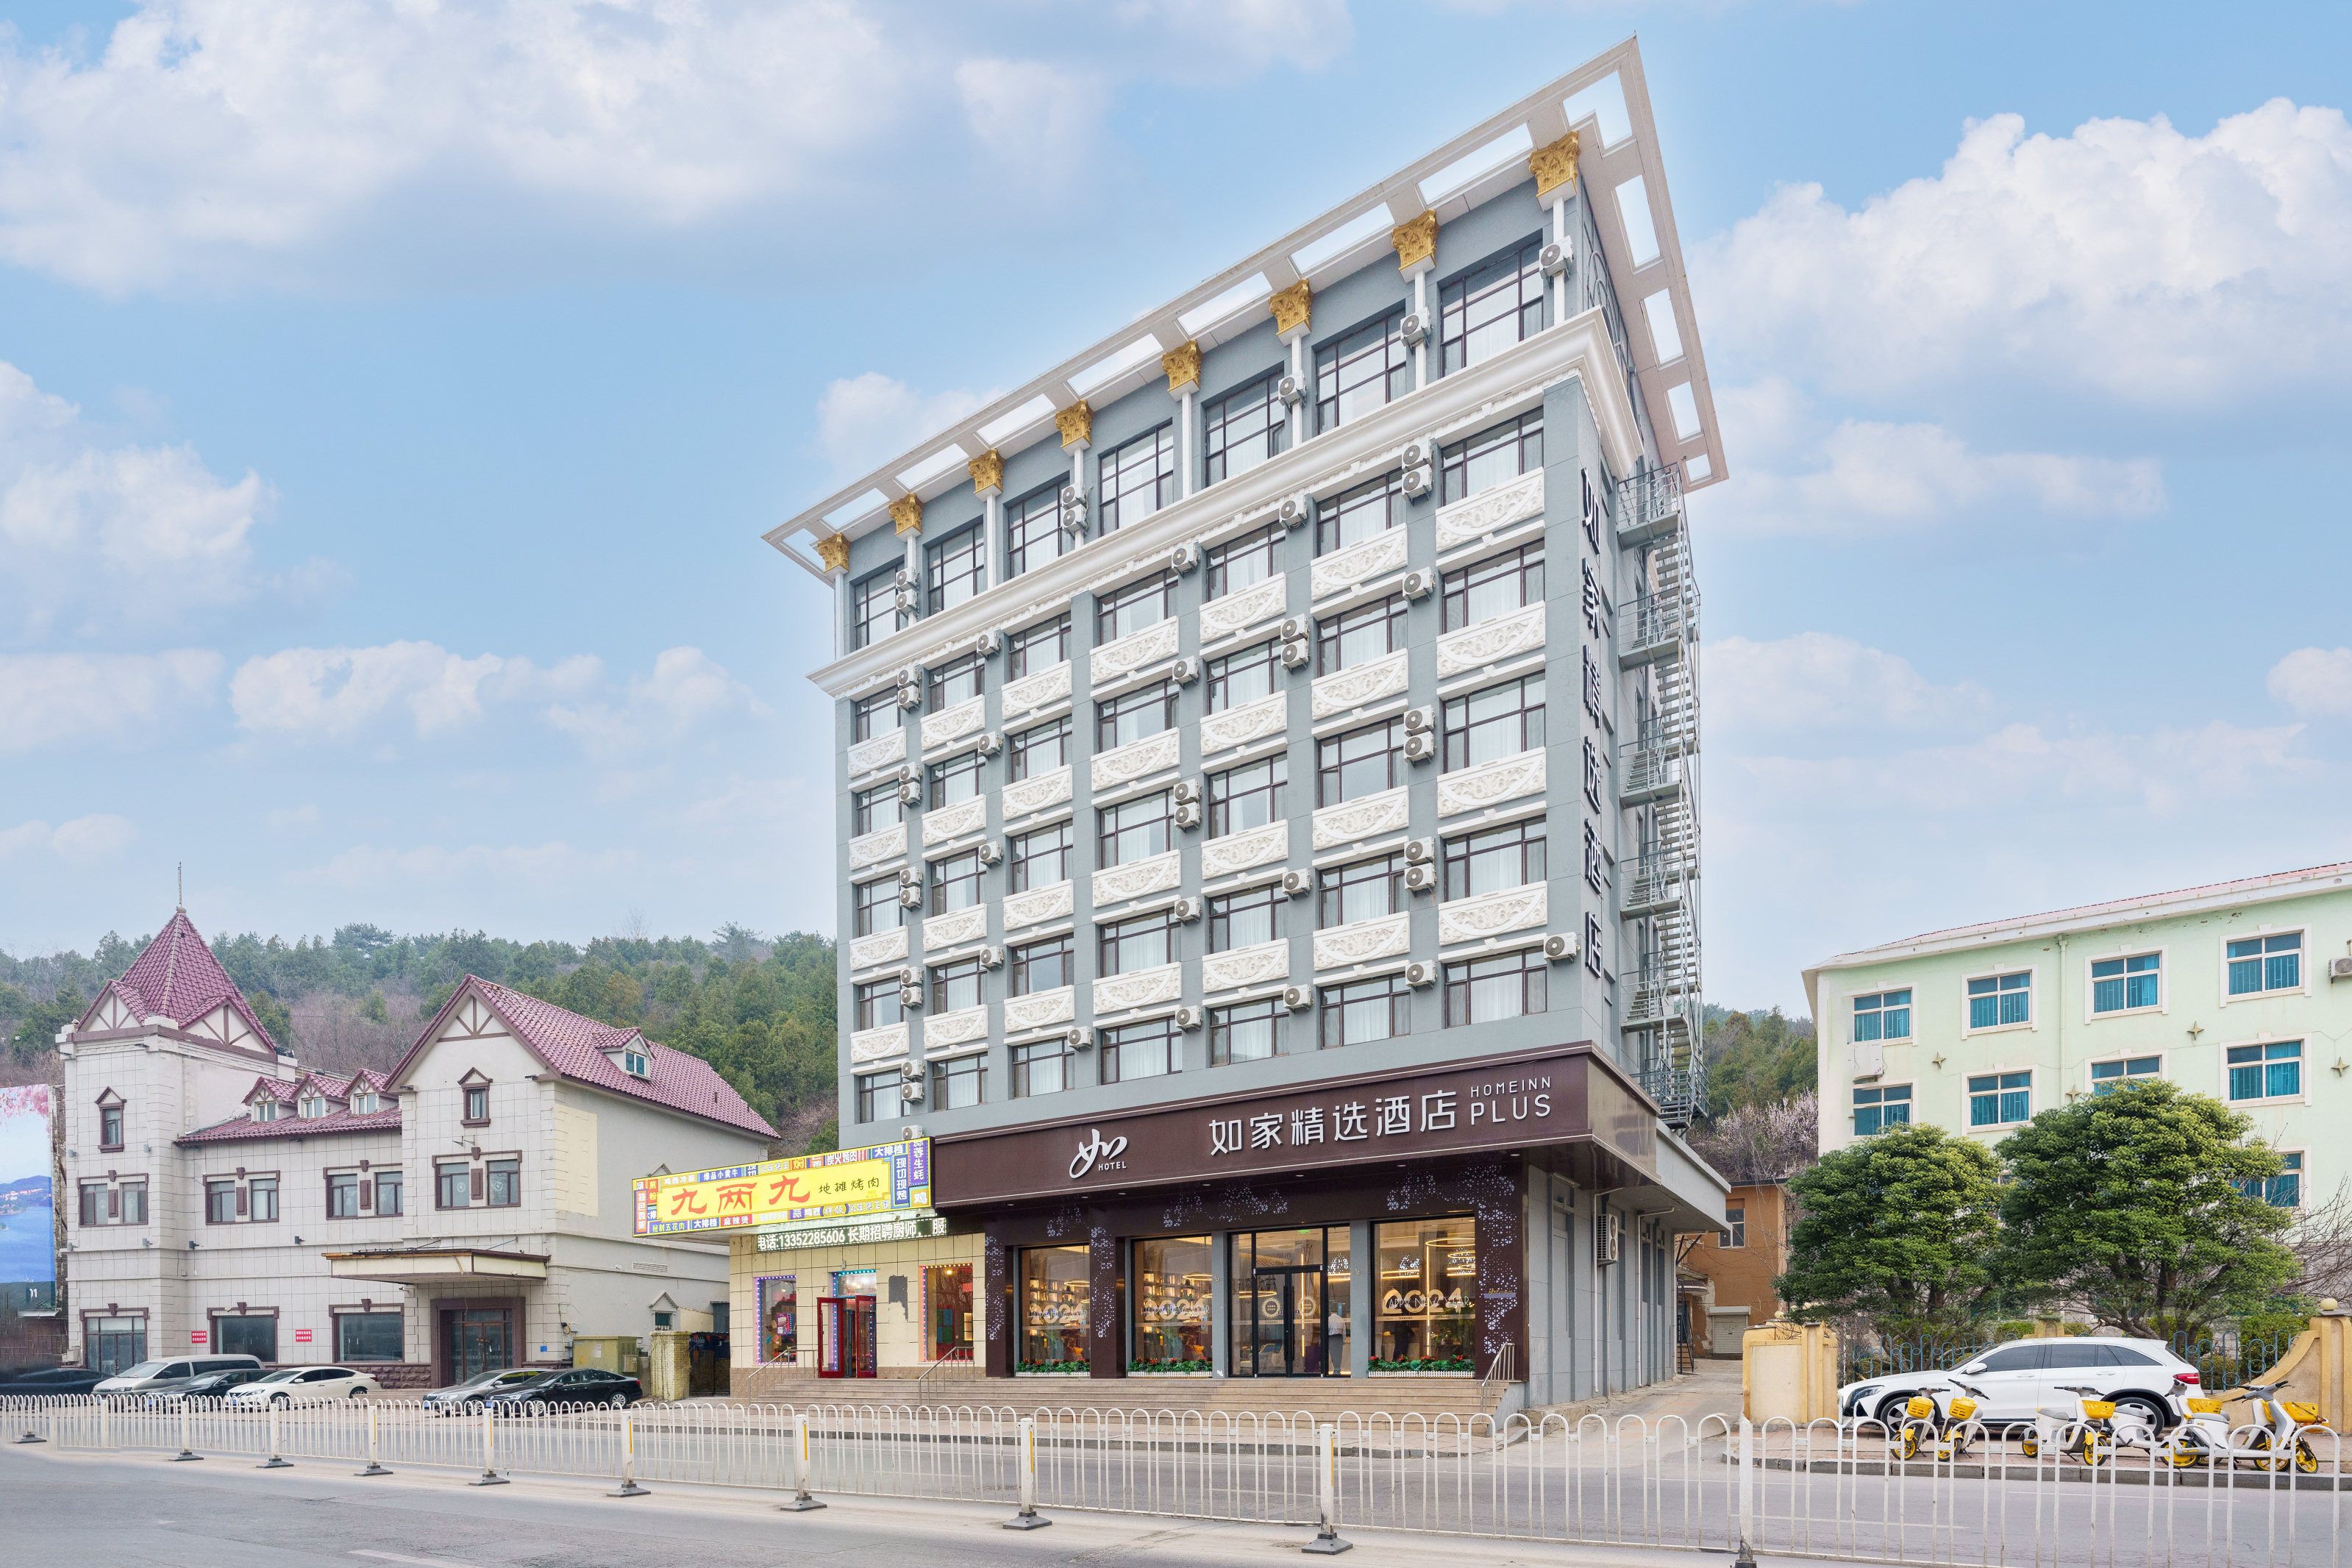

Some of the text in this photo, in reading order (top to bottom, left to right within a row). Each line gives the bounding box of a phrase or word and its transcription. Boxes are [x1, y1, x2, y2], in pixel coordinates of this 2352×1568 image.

[1581, 466, 1602, 979] 如家精选酒店
[1471, 1076, 1550, 1098] HOMEINN
[1471, 1094, 1551, 1125] PLUS
[1208, 1089, 1456, 1156] 如家精选酒店
[874, 1144, 904, 1157] 大排档
[703, 1168, 738, 1181] 爆品小黄牛
[1098, 1161, 1127, 1171] HOTEL
[818, 1176, 880, 1195] 地摊烤肉
[896, 1157, 908, 1201] 现切现烤
[670, 1175, 810, 1216] 九两九
[848, 1200, 890, 1213] 风味烤羊腿
[913, 1191, 928, 1205] 鸡
[638, 1192, 646, 1230] 特色鸡架
[724, 1216, 749, 1226] 麻辣烫
[652, 1222, 685, 1233] 秘制五花肉
[694, 1218, 718, 1229] 大排档
[1144, 1297, 1207, 1321] 2024
[1383, 1287, 1465, 1314] 2024
[1030, 1302, 1085, 1325] 2024
